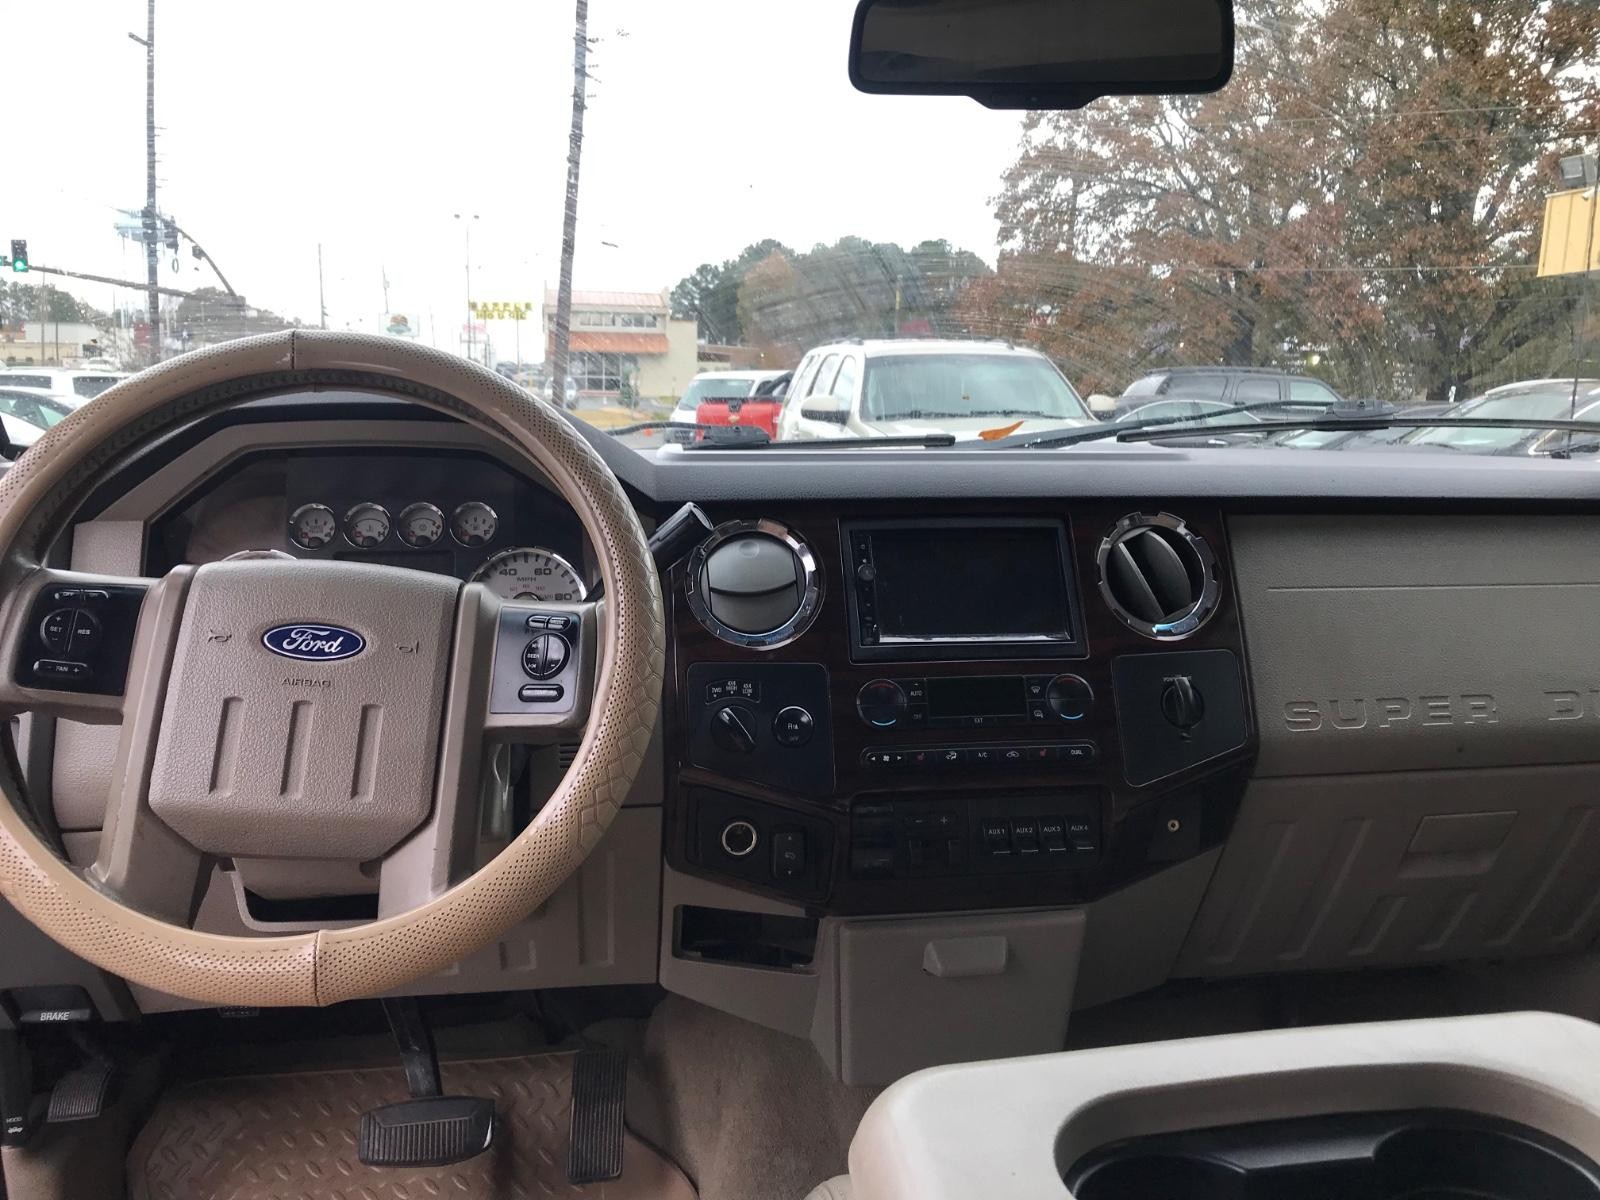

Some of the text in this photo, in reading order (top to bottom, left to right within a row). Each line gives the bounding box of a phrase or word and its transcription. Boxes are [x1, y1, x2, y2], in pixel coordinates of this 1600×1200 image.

[498, 568, 518, 576] 40
[534, 568, 552, 576] 60
[554, 592, 573, 600] 80
[49, 625, 63, 633] SET
[282, 628, 343, 654] Ford
[281, 678, 331, 687] AIRBAG
[1283, 694, 1499, 732] SUPER
[977, 751, 989, 759] A/C
[40, 1011, 71, 1022] BRAKE
